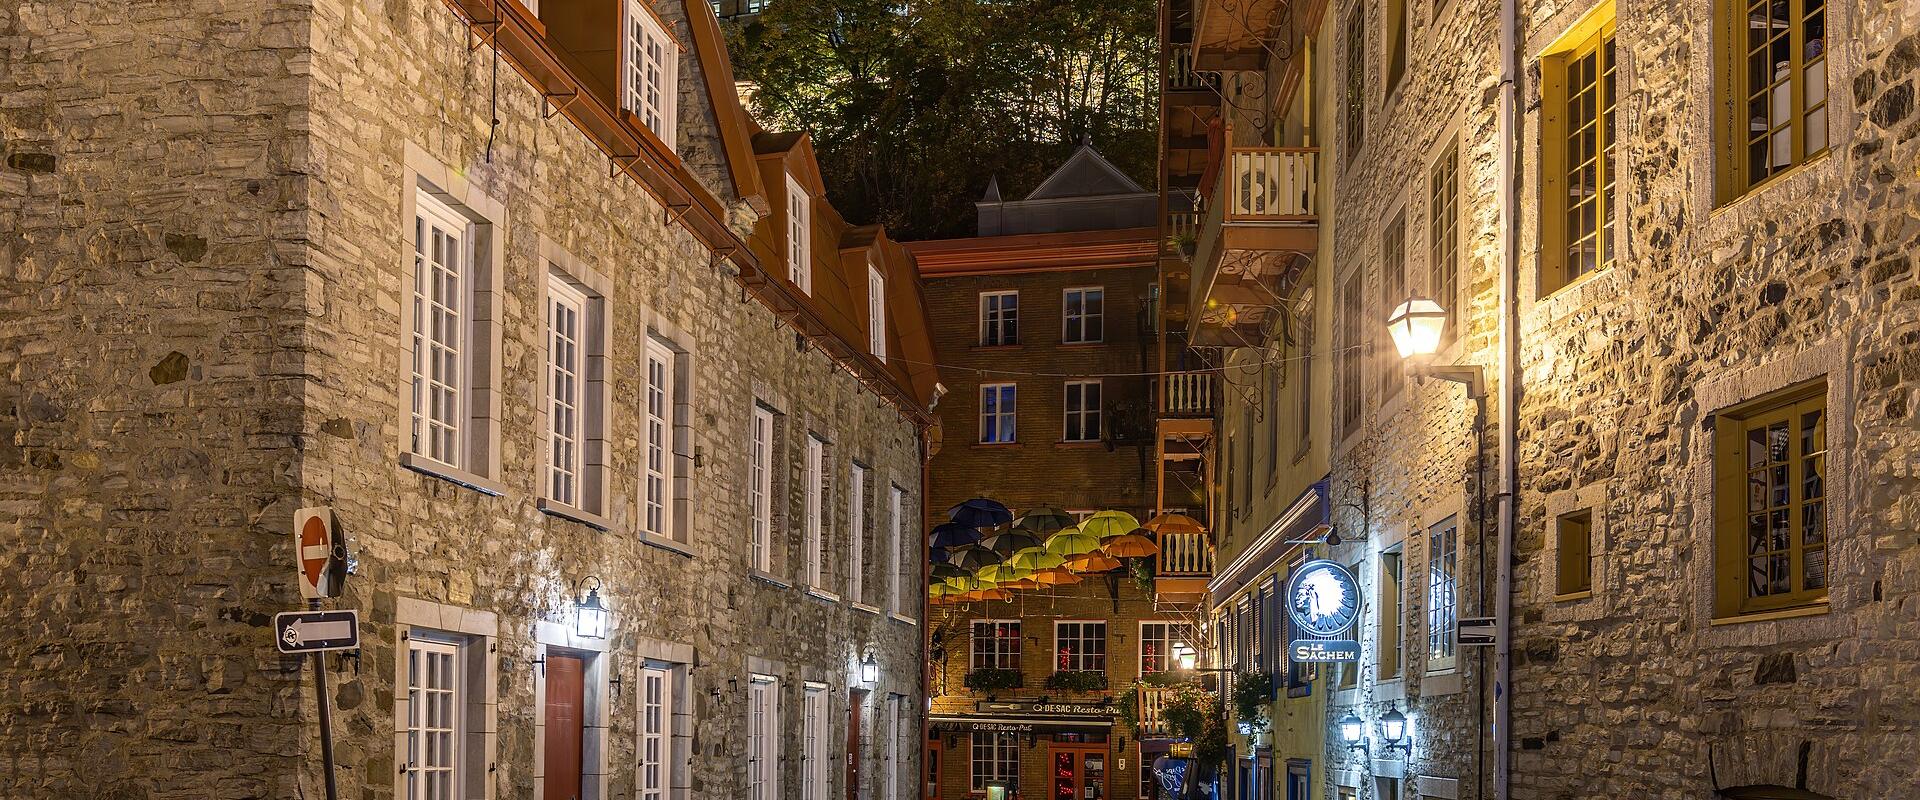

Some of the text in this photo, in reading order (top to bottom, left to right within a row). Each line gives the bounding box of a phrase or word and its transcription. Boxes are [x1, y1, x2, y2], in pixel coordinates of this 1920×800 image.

[1310, 643, 1324, 651] LE
[1296, 645, 1355, 660] SACHEM
[1073, 704, 1121, 714] Resto-Pu
